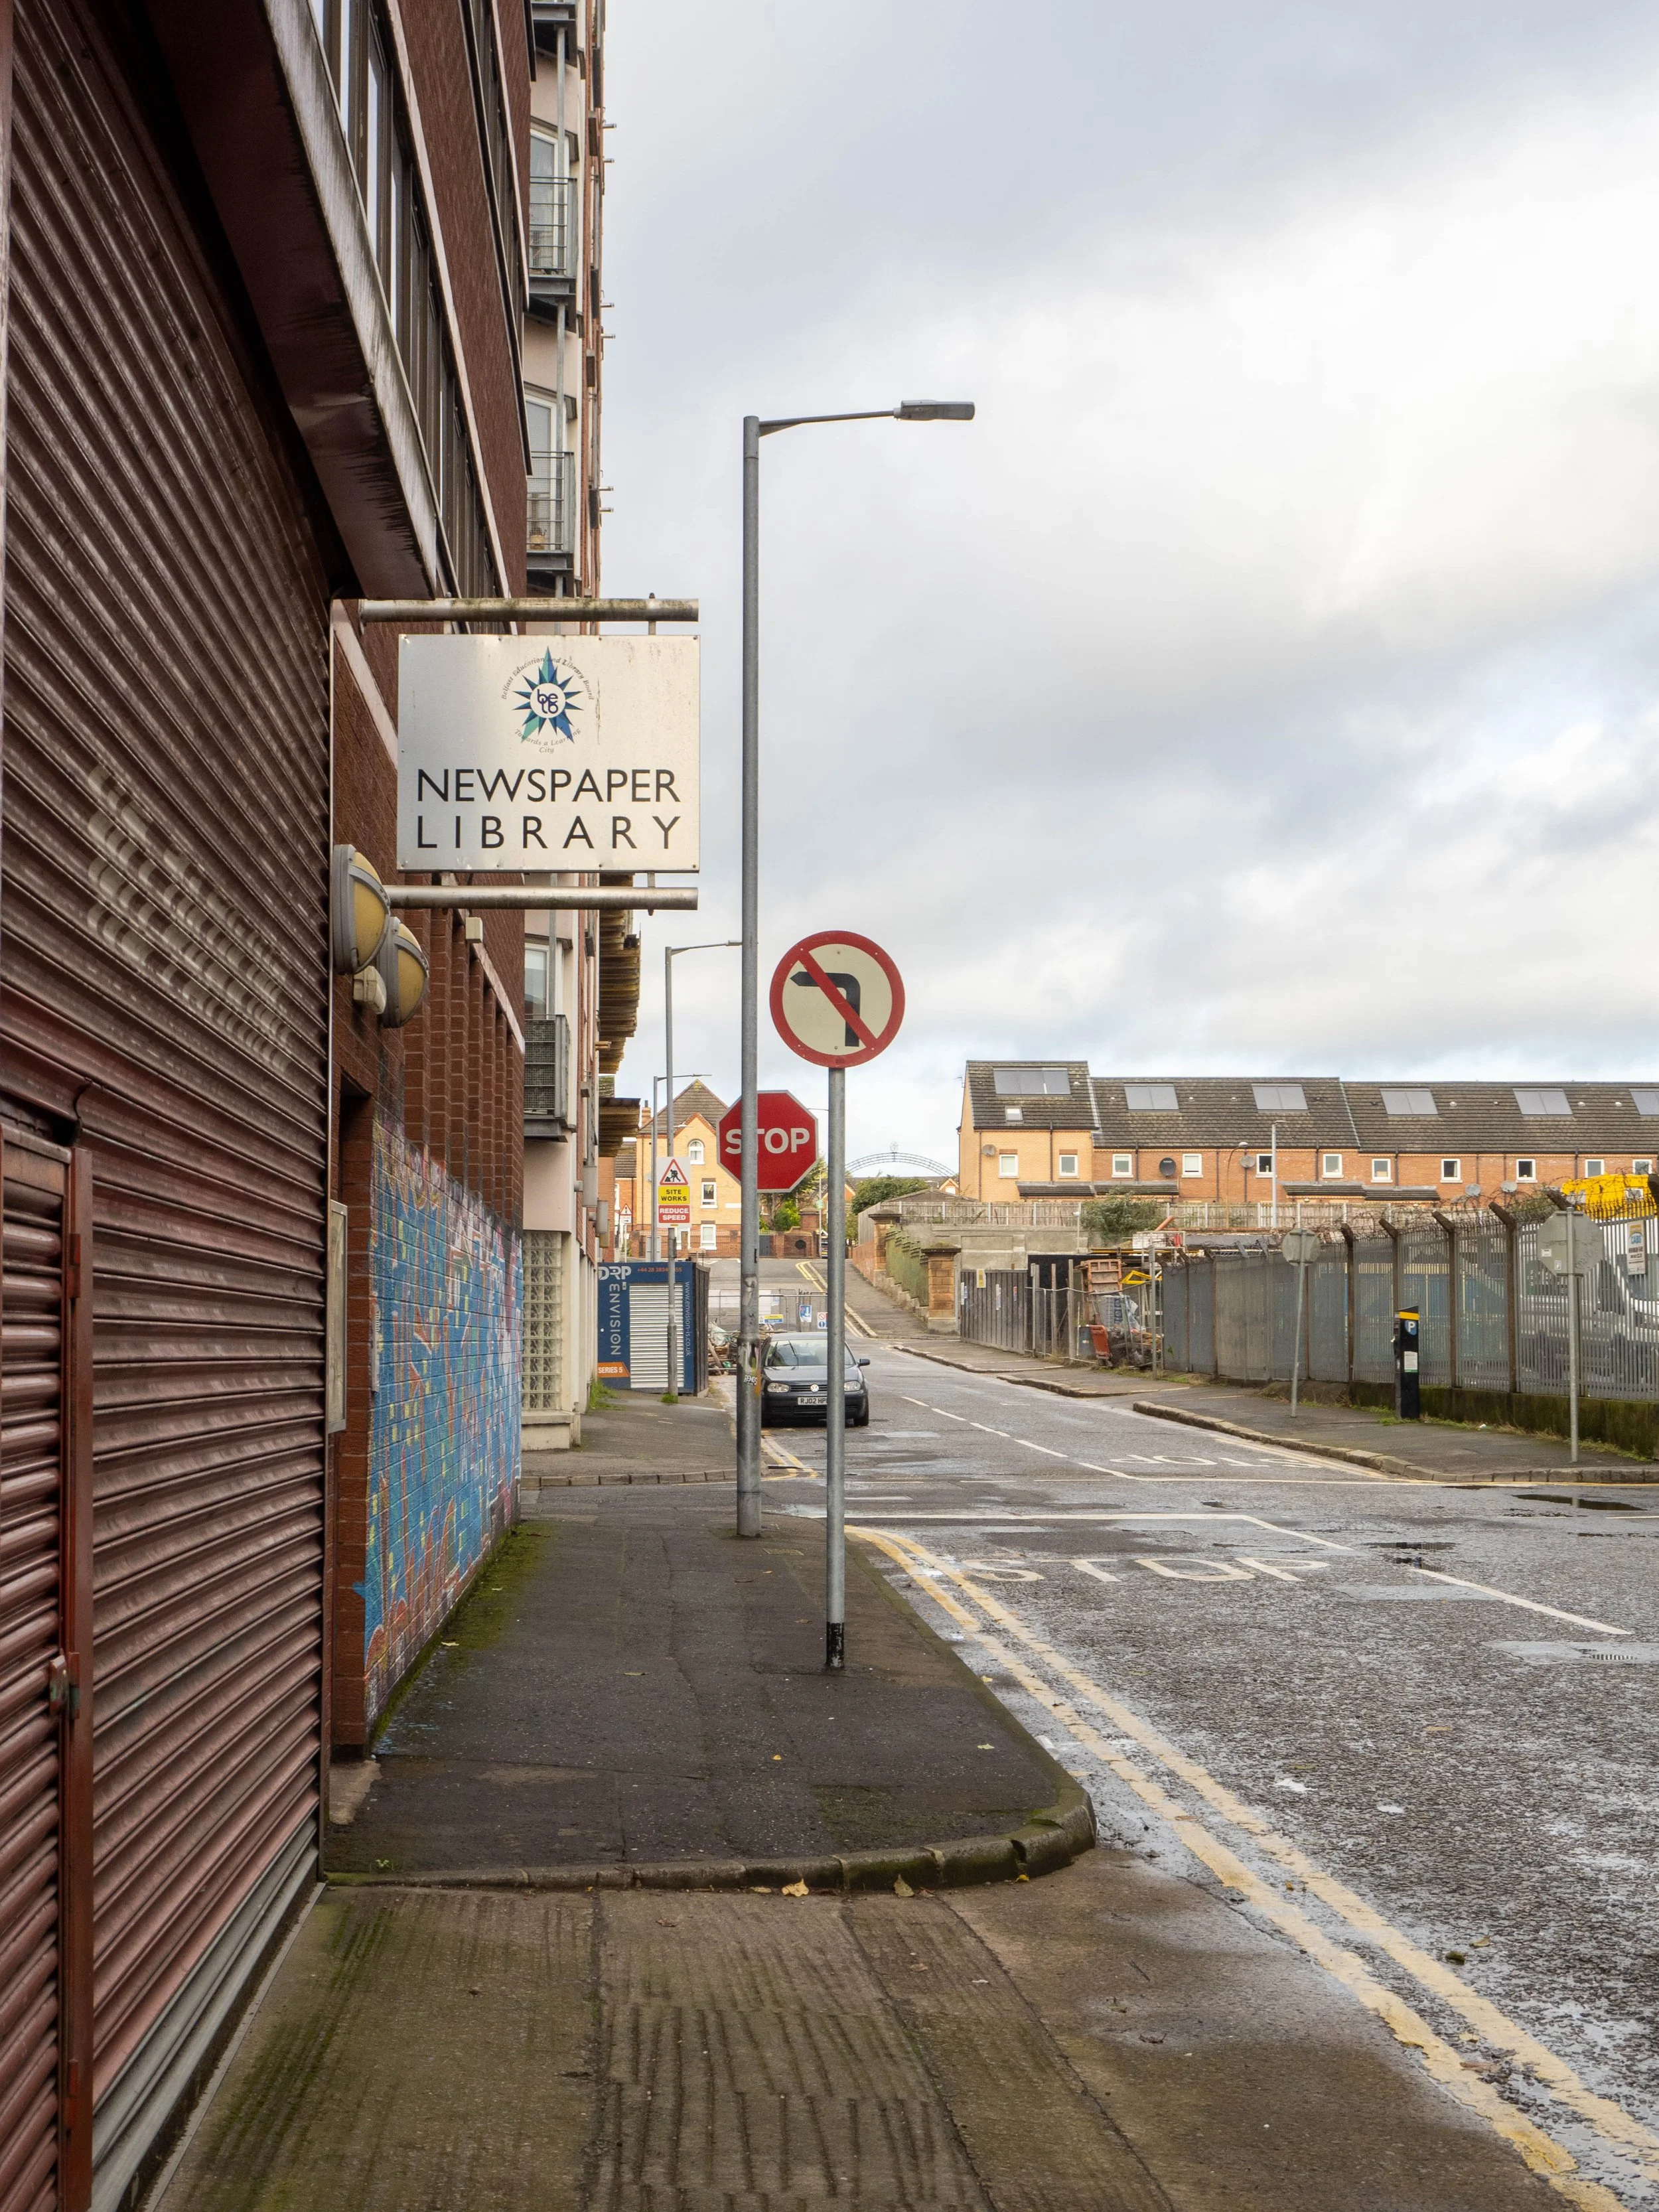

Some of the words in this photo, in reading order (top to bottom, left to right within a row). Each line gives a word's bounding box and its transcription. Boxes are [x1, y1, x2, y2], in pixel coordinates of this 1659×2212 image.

[501, 676, 514, 700] Belfast
[512, 657, 545, 677] Education
[562, 658, 585, 680] Library
[583, 680, 595, 700] Board
[417, 769, 682, 802] NEWSPAPER
[417, 815, 682, 849] LIBRARY
[599, 1266, 632, 1281] DRP
[609, 1283, 622, 1355] ENVISION
[1407, 1321, 1415, 1333] P
[962, 1558, 1333, 1583] STOP
